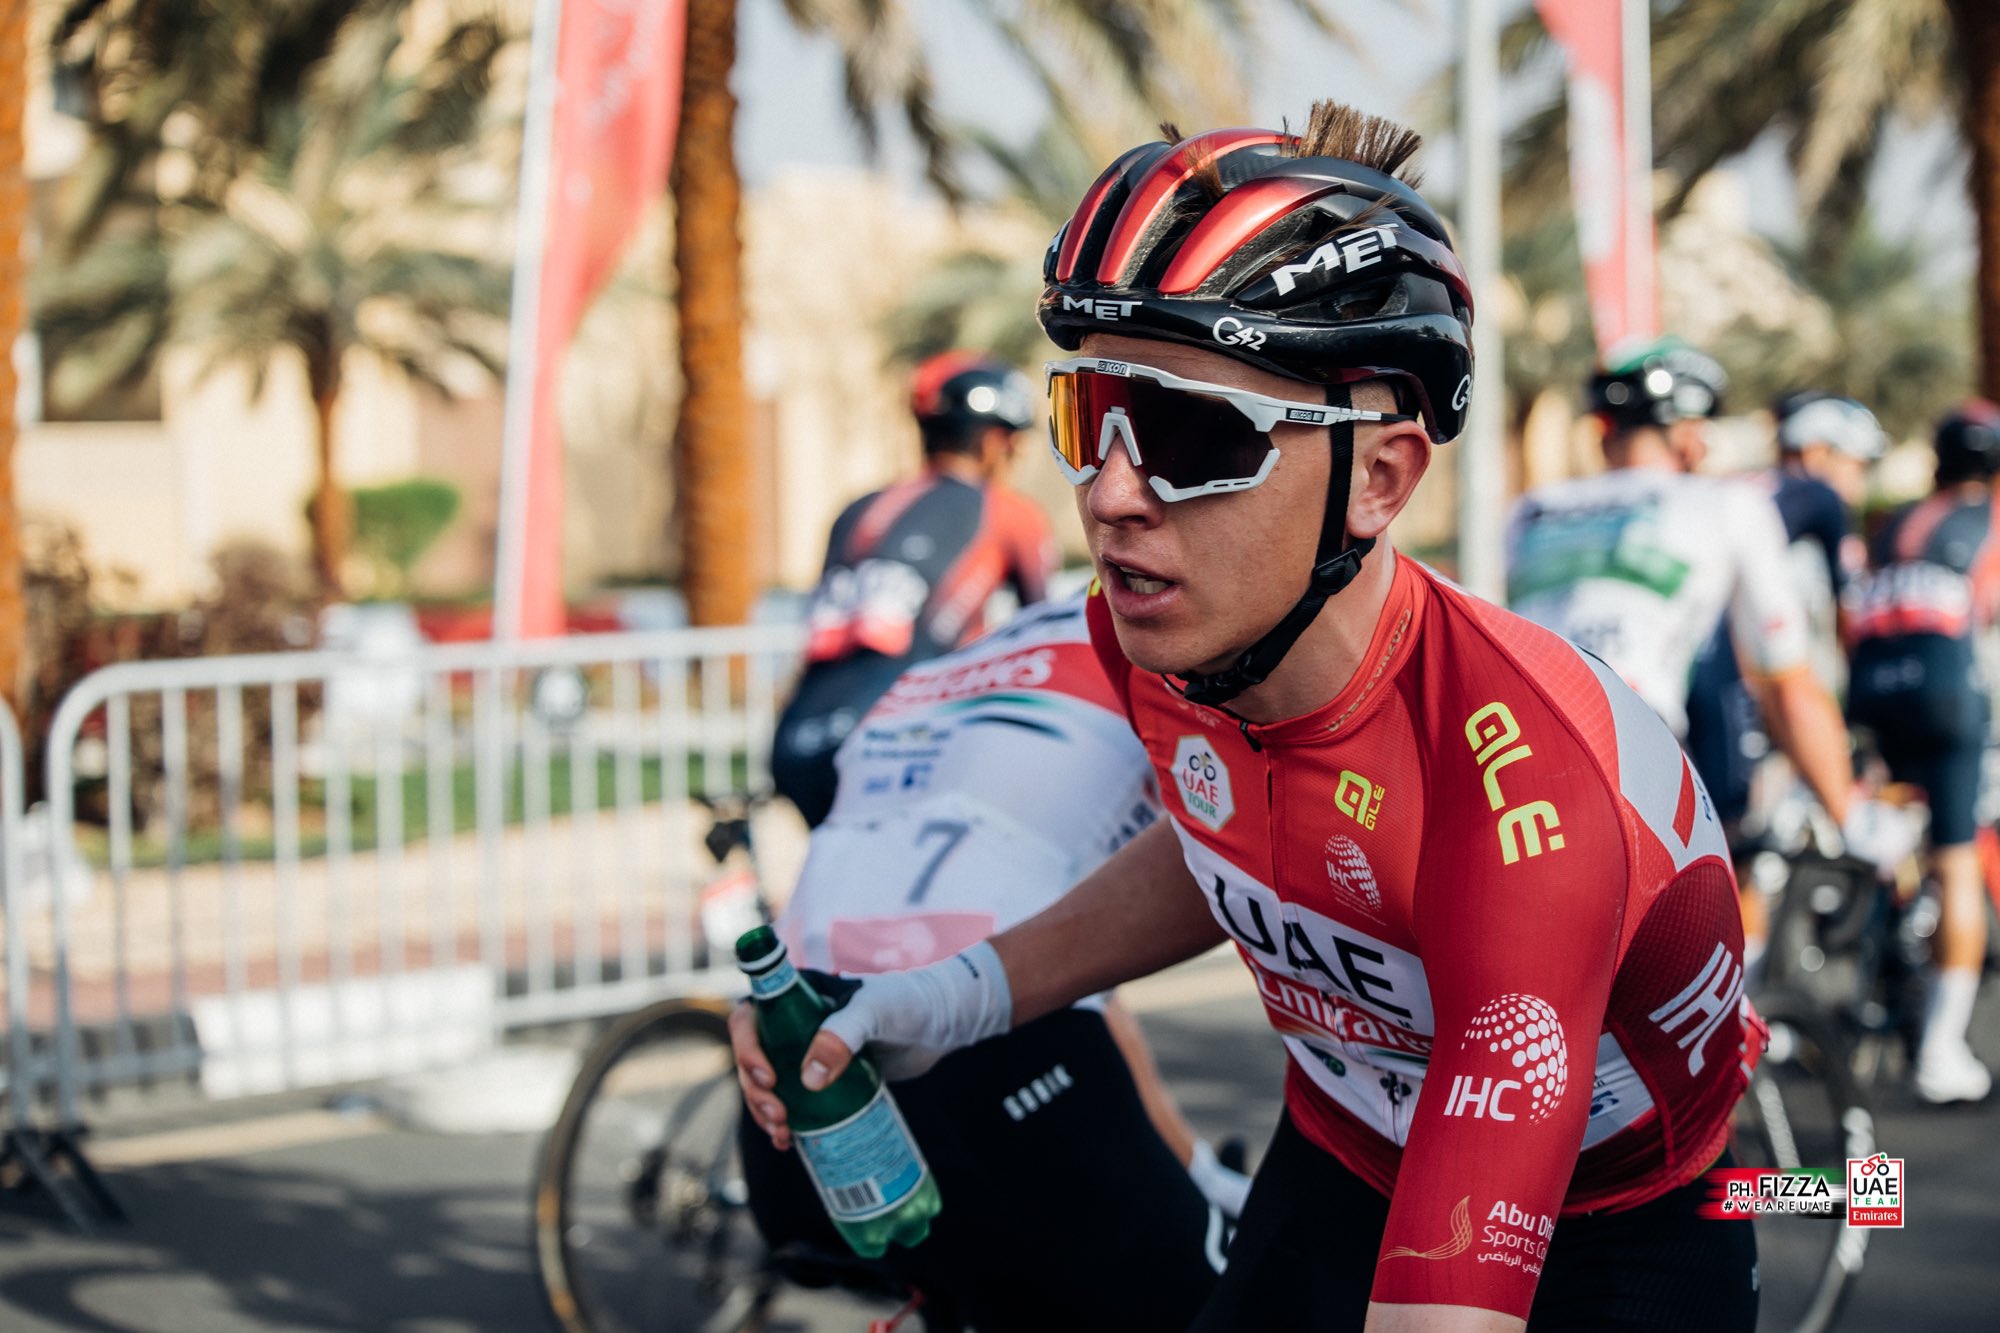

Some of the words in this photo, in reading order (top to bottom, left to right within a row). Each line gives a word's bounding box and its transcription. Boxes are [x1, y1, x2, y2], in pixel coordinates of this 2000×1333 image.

[1271, 223, 1399, 296] MET
[1063, 295, 1143, 321] MET
[1212, 316, 1267, 351] G42
[1183, 768, 1220, 807] UAE
[1187, 790, 1217, 819] TOUR
[914, 820, 971, 904] 7
[1214, 873, 1413, 1019] UAE
[1443, 1075, 1522, 1122] IHC
[1487, 1200, 1536, 1232] Abu
[1481, 1225, 1536, 1255] Sports
